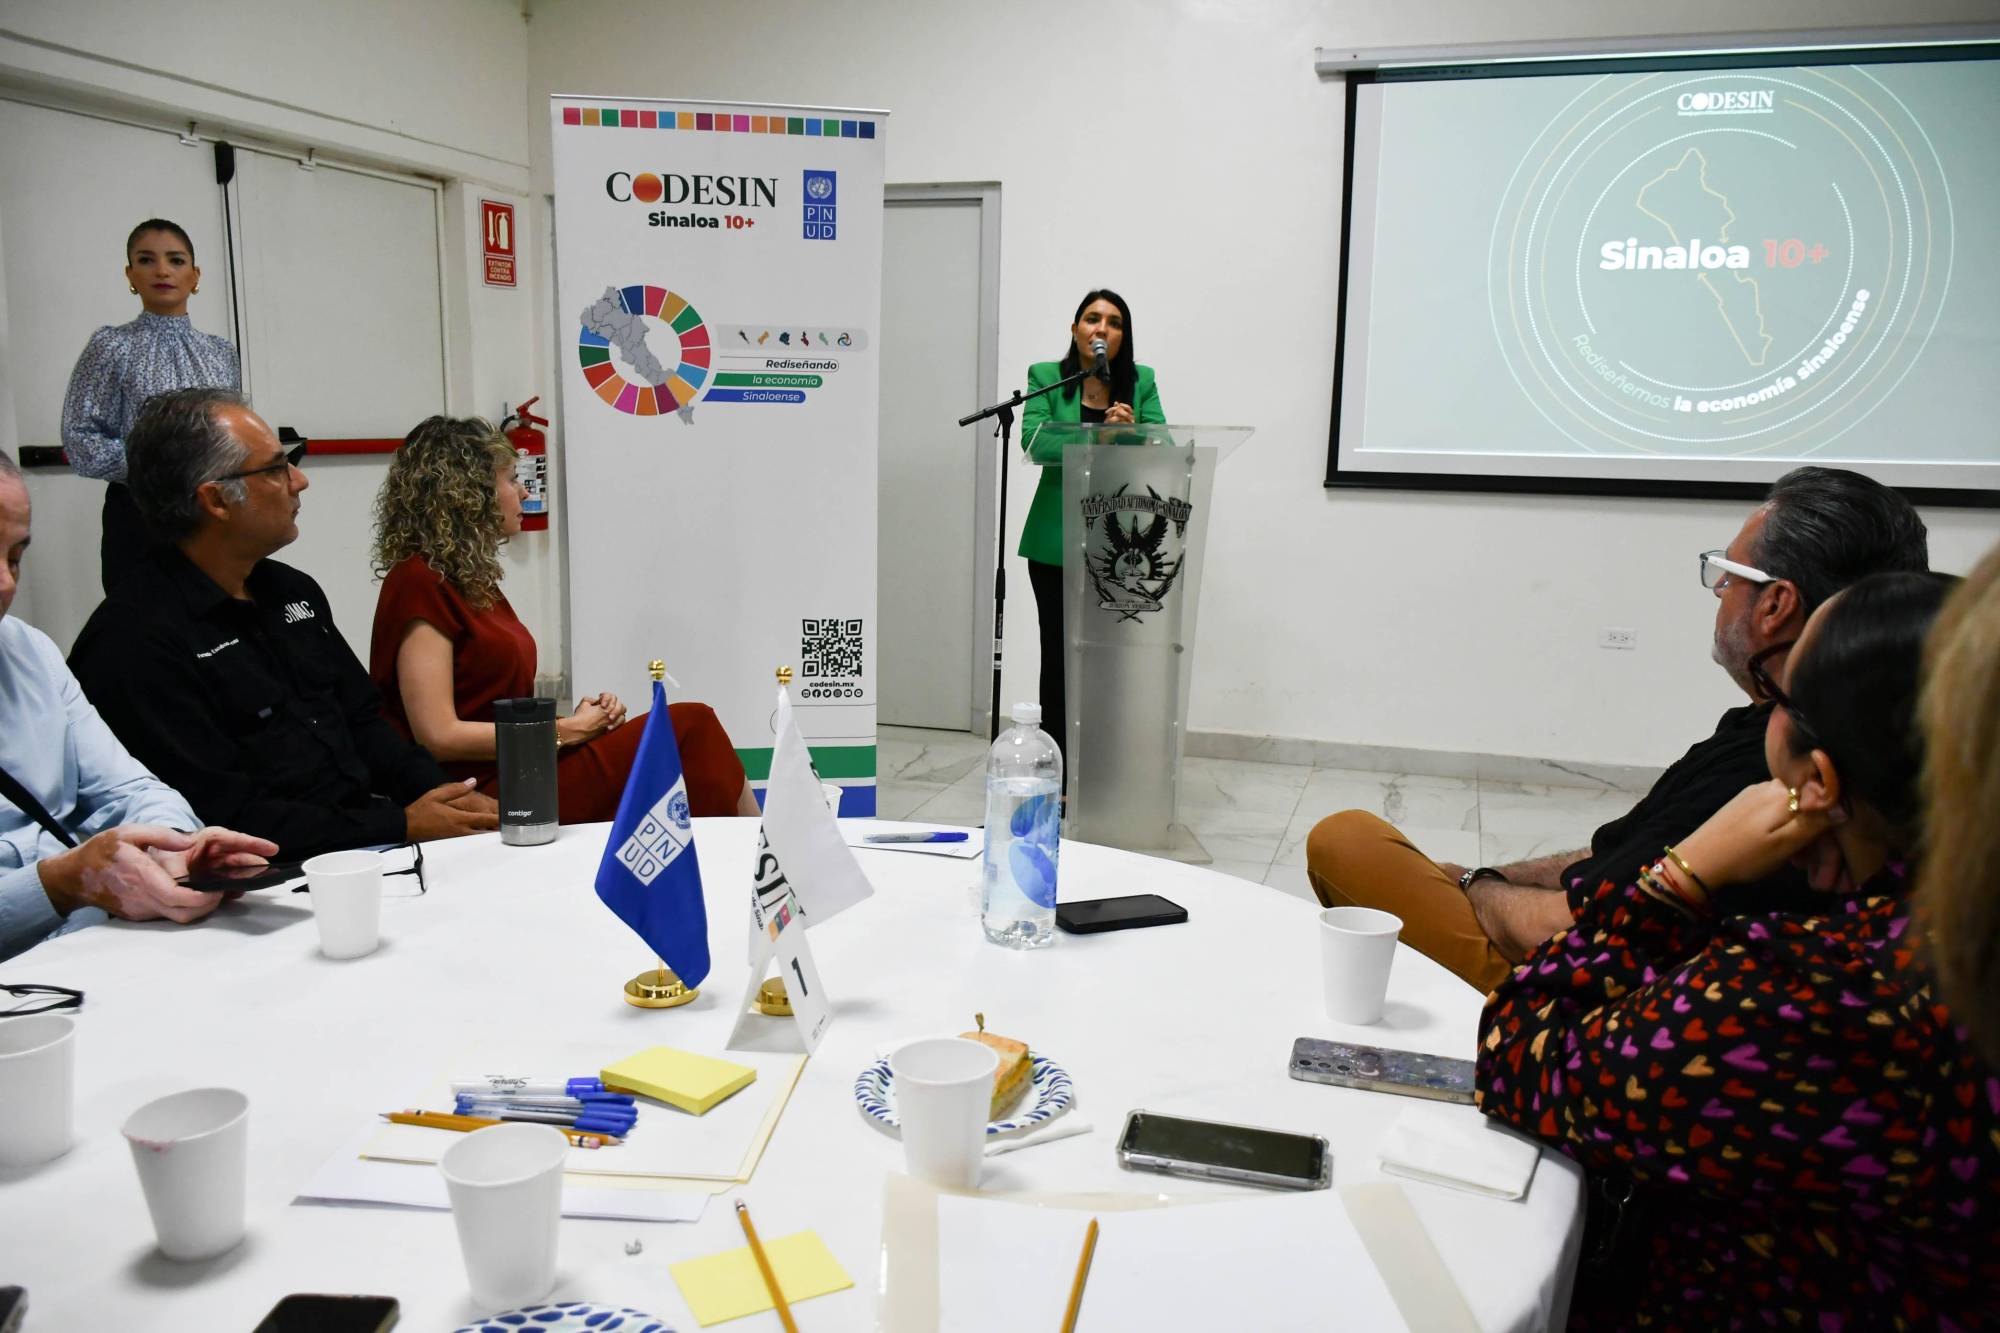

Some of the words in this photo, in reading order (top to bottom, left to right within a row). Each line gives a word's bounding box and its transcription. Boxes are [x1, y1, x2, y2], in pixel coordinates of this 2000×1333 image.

[1677, 90, 1775, 111] CODESIN
[606, 171, 779, 208] CODESIN
[648, 211, 719, 229] Sinaloa
[724, 215, 755, 230] 10+
[1599, 237, 1750, 271] Sinaloa
[1762, 238, 1829, 269] 10+
[1573, 333, 1671, 410] Rediseñemos
[1673, 395, 1692, 413] la
[1696, 376, 1796, 413] economía
[1796, 288, 1870, 381] sinaloense
[765, 359, 837, 370] Rediseñando
[752, 375, 762, 384] la
[765, 376, 818, 386] economía
[742, 391, 800, 402] Sinaloense
[508, 809, 532, 818] contigo
[791, 956, 808, 998] 1
